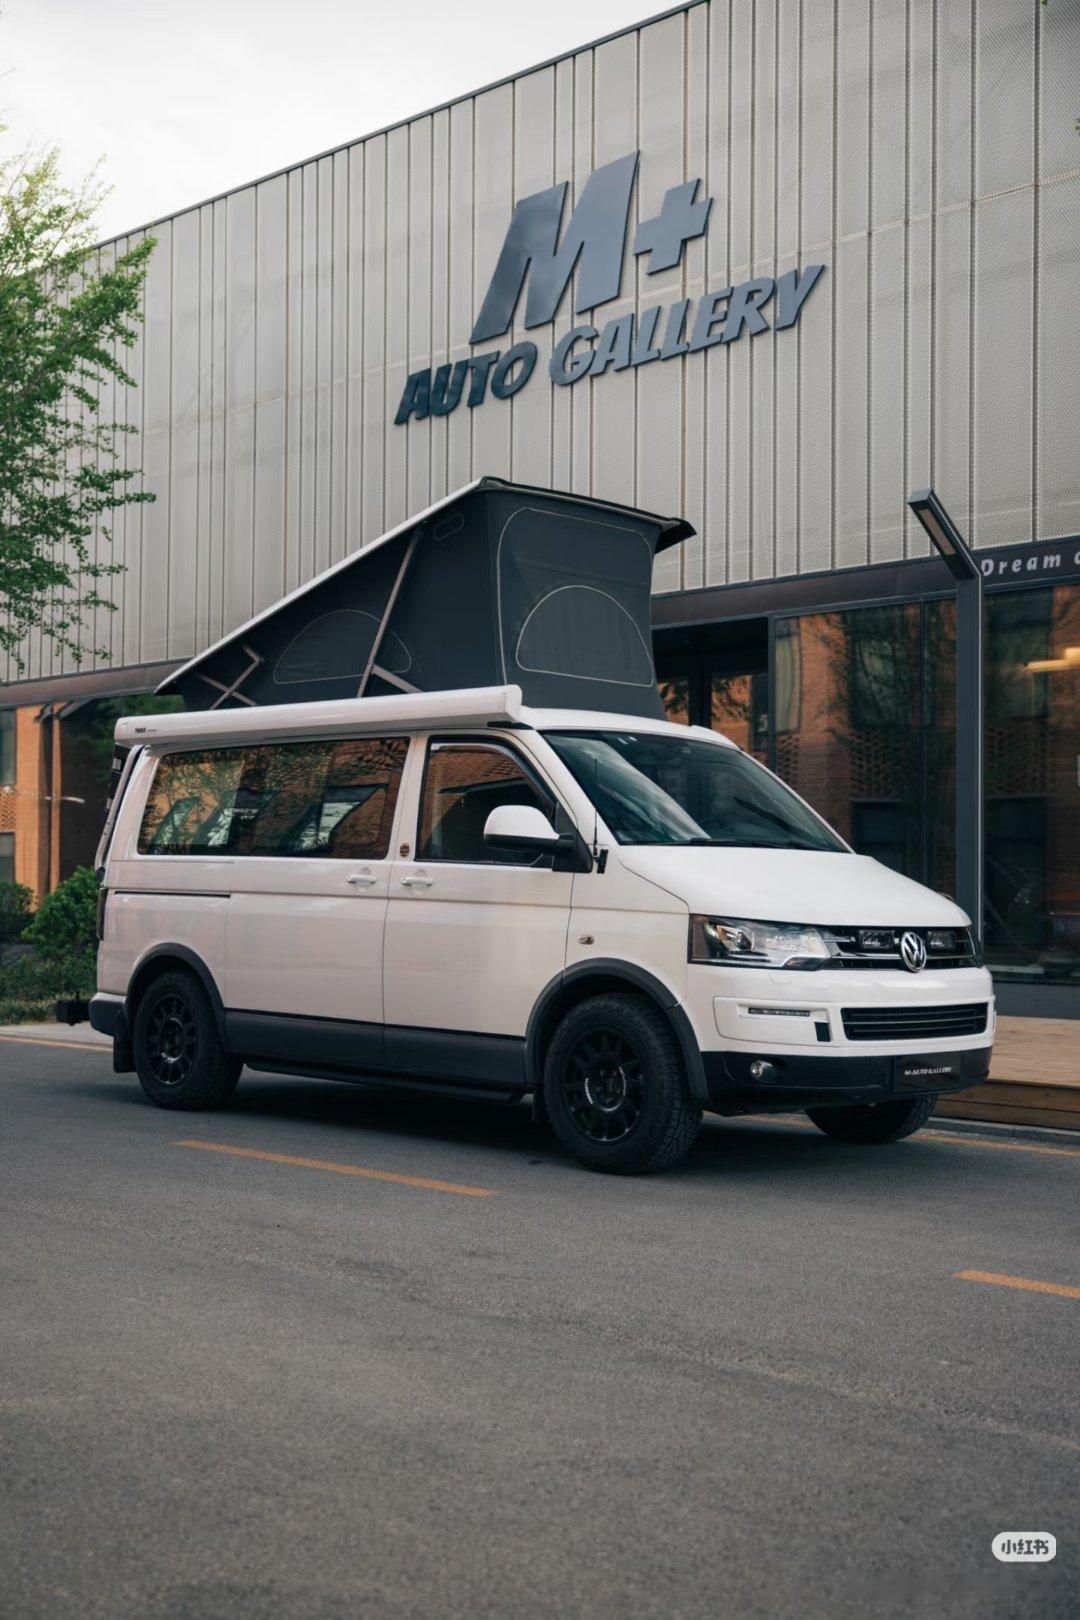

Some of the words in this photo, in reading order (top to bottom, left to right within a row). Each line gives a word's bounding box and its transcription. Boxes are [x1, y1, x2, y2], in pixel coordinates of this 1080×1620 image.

[469, 150, 713, 345] M+
[394, 341, 537, 426] AUTO
[549, 264, 826, 387] GALLERY
[981, 554, 1061, 577] Dream
